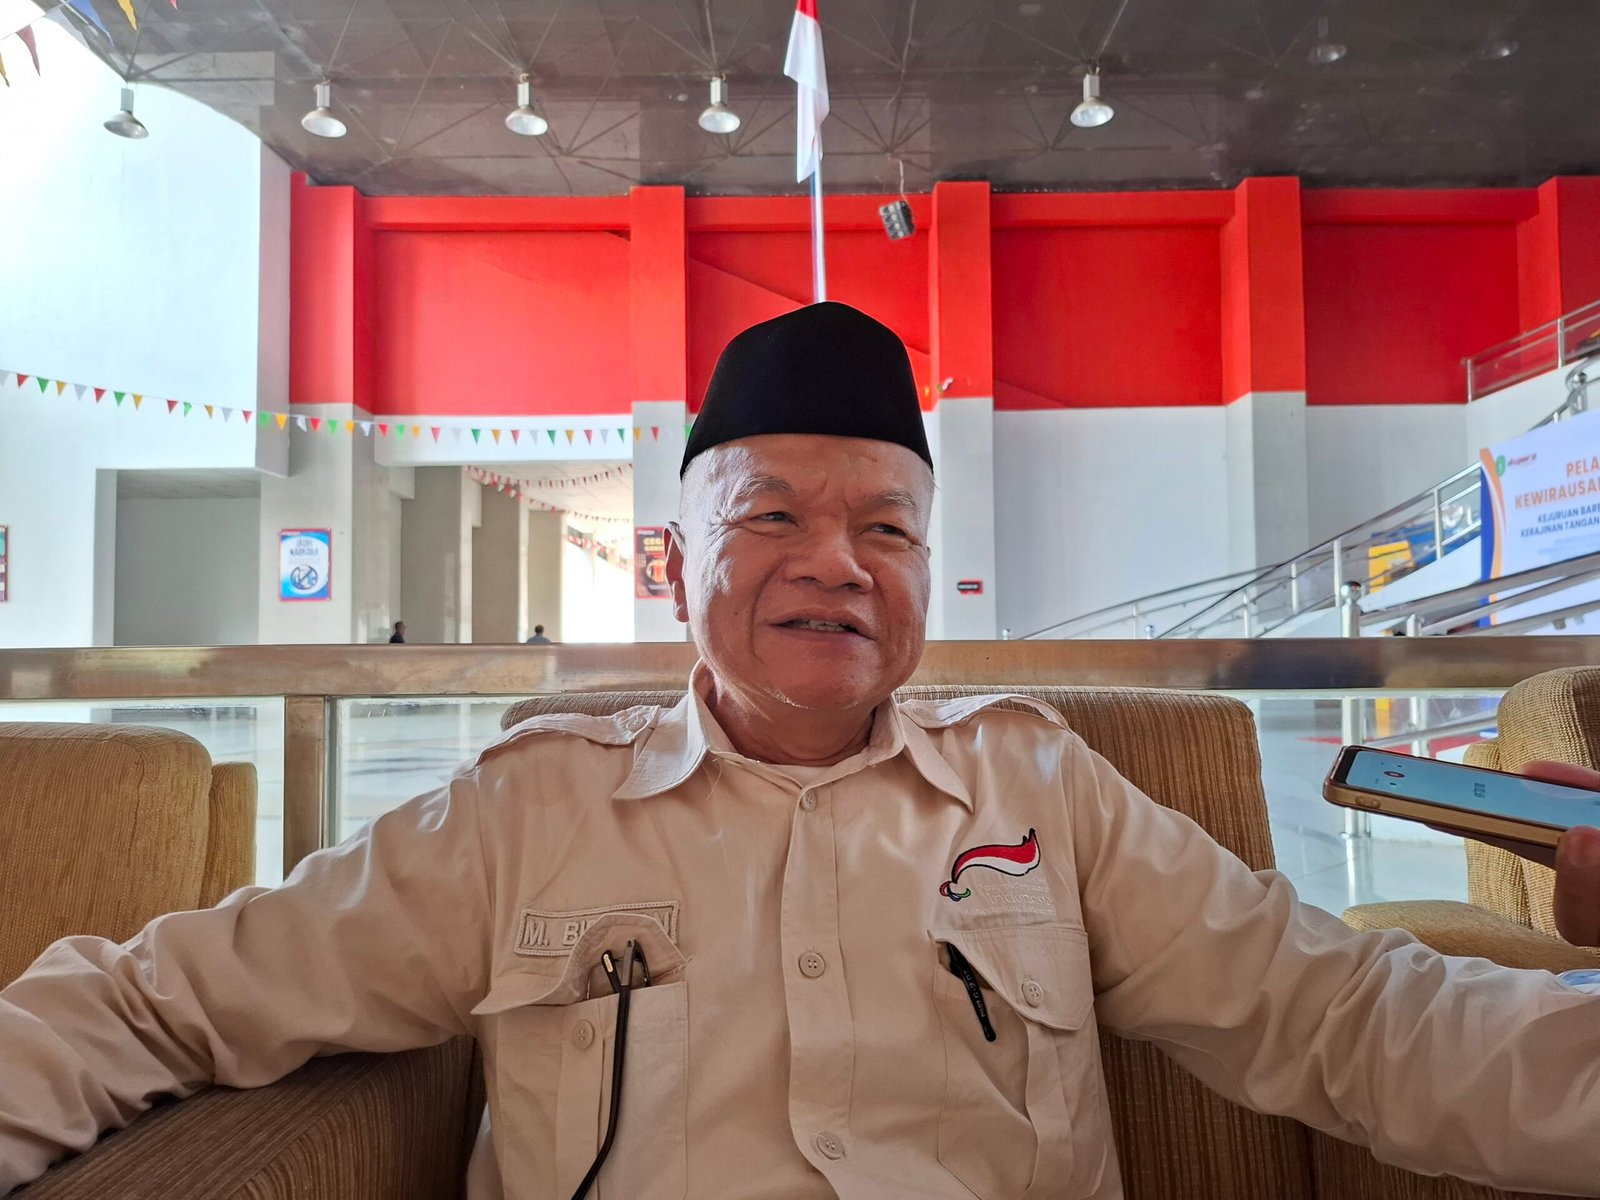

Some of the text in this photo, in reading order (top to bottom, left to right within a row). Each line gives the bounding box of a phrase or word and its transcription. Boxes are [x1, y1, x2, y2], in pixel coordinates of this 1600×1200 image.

[1515, 477, 1600, 509] KEWIRAUSA
[1538, 508, 1579, 523] KEJURUAN
[1520, 516, 1600, 538] KERAJINAN TANGAN
[522, 918, 549, 946] M.
[969, 982, 980, 999] G-2
